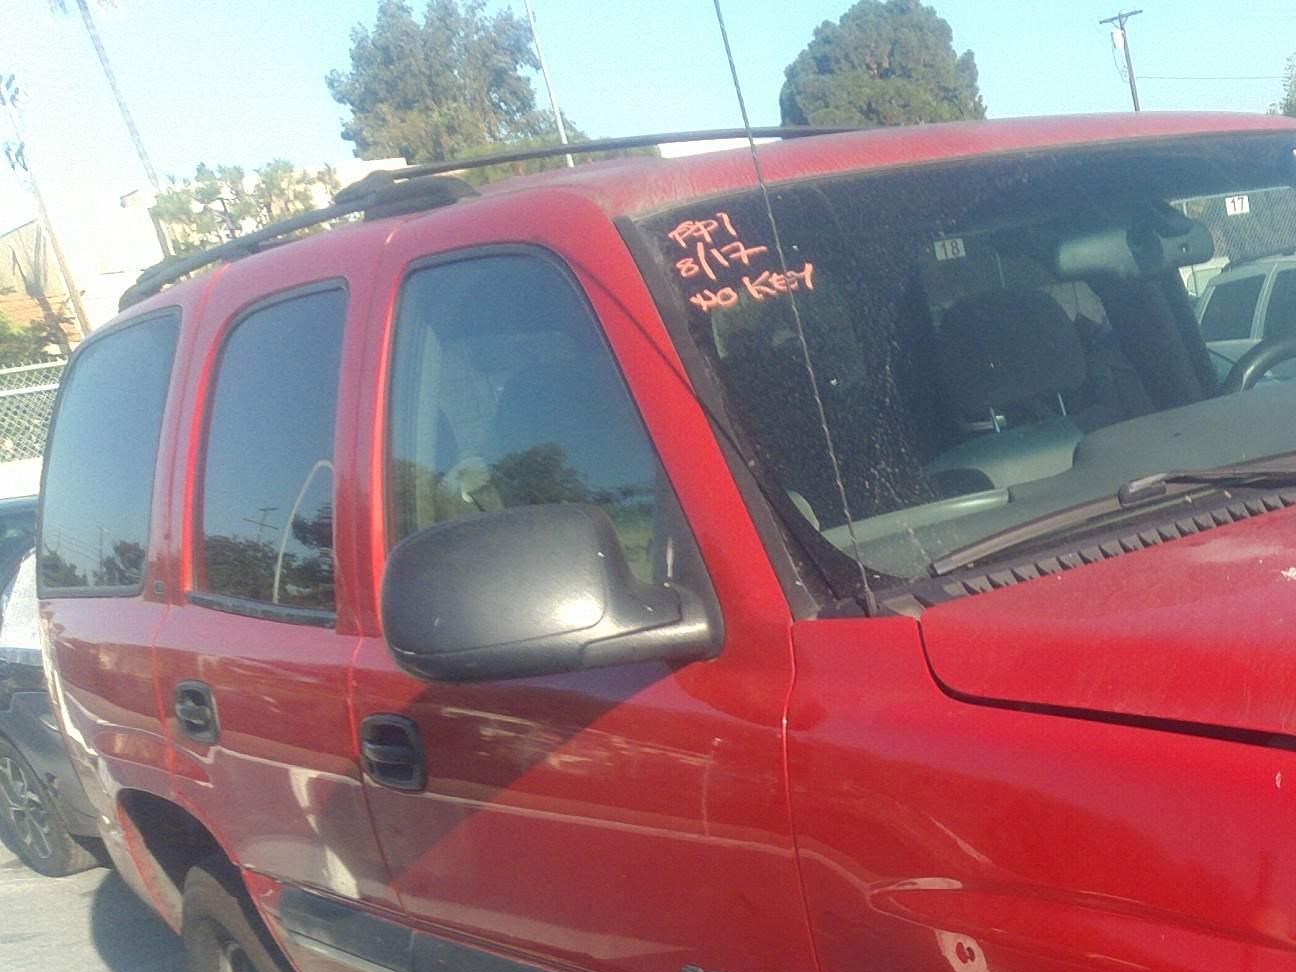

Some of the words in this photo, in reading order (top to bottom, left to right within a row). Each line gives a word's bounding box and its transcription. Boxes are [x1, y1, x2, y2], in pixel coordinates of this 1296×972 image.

[1231, 196, 1244, 212] 17
[941, 240, 961, 258] 18
[676, 242, 769, 281] 8/17
